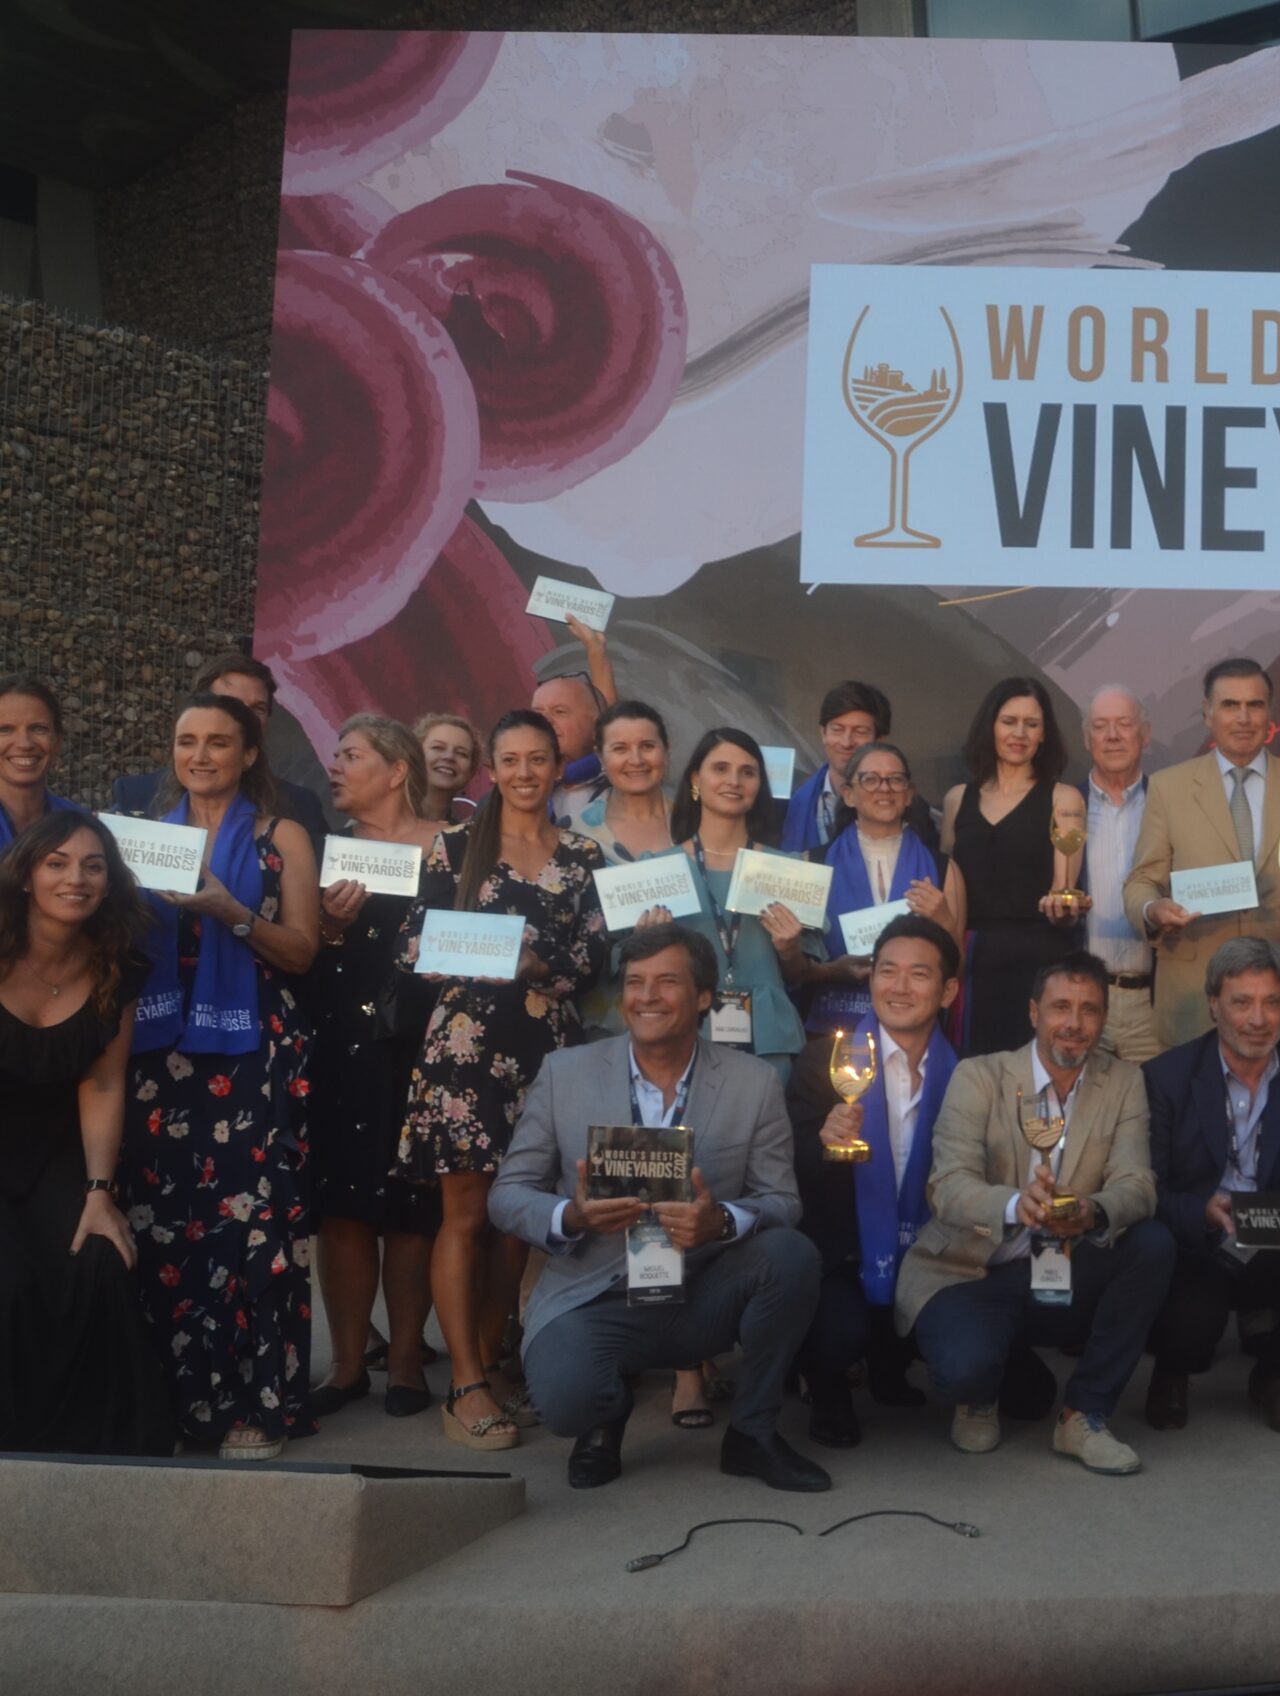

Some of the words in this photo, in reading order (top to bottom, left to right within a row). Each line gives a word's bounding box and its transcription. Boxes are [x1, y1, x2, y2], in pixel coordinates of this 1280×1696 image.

[121, 838, 156, 850] ORLD'S
[159, 843, 184, 855] BEST
[120, 847, 182, 870] INEYARDS
[182, 847, 198, 872] 2023
[340, 860, 402, 878] VINEYARDS
[616, 883, 679, 907] VINEYARDS
[753, 880, 811, 905] VINEYARDS
[438, 939, 502, 957] VINEYARDS
[135, 1001, 179, 1022] EYARDS
[604, 1149, 646, 1160] WORLD'S
[650, 1151, 673, 1161] BEST
[673, 1151, 687, 1180] 2023
[604, 1160, 673, 1178] VINEYARDS
